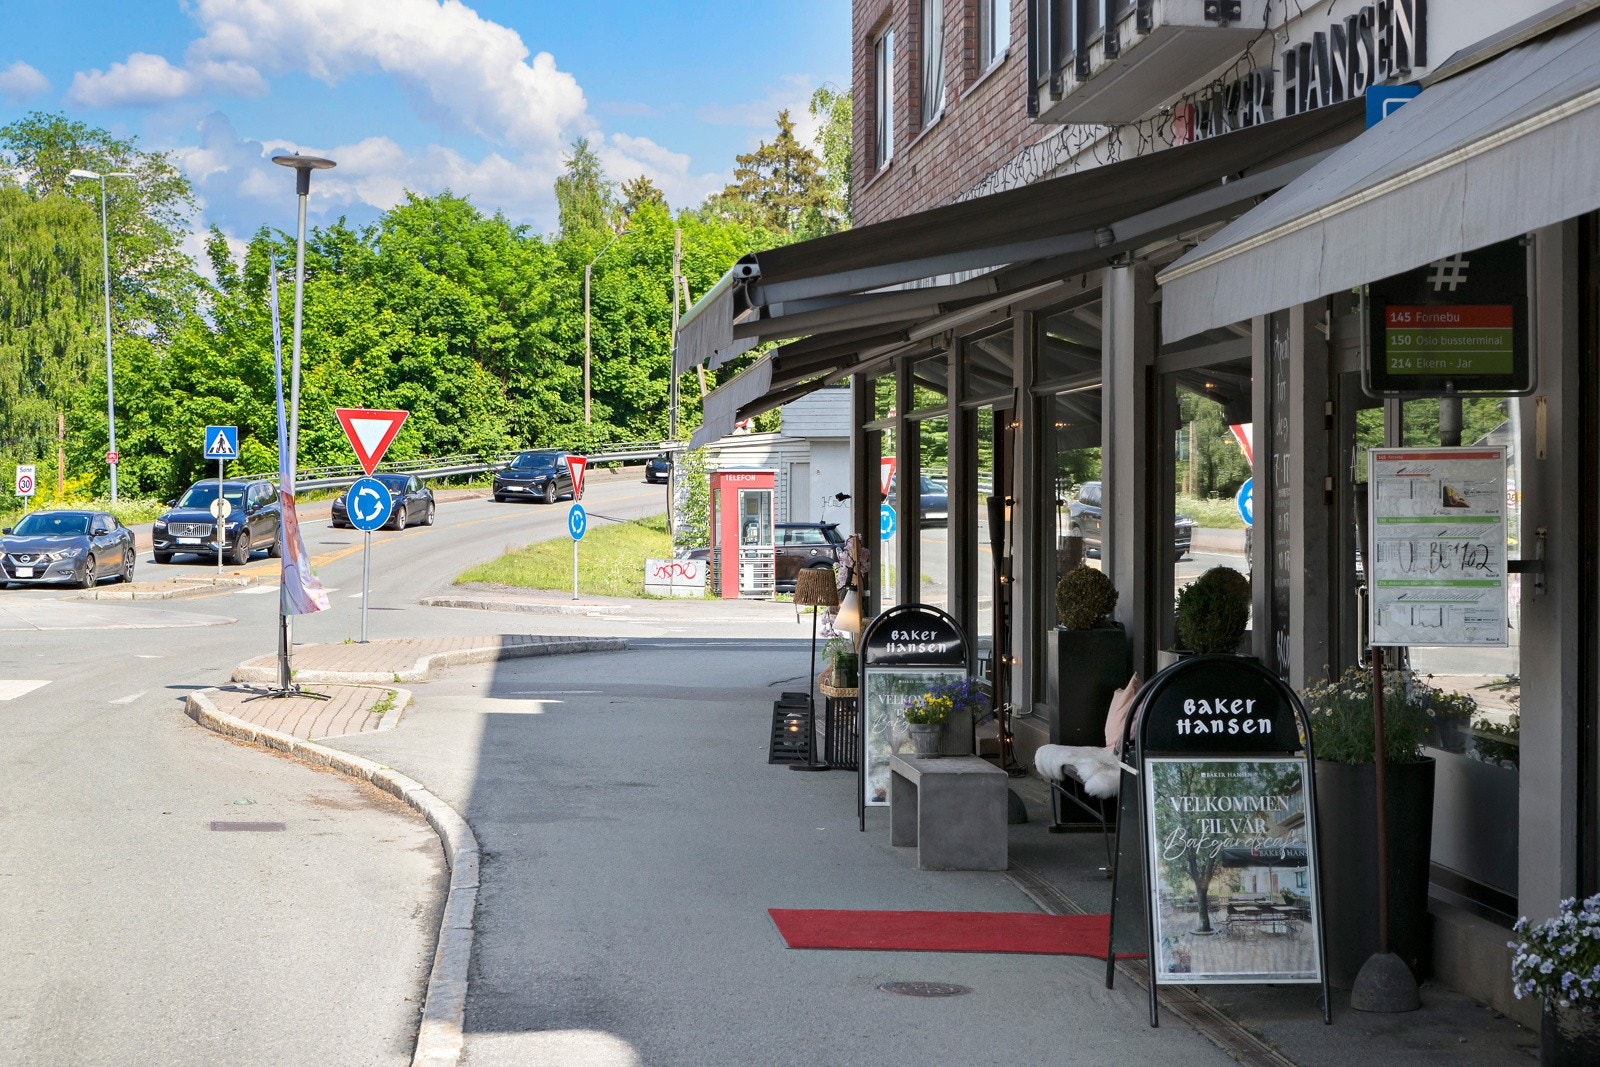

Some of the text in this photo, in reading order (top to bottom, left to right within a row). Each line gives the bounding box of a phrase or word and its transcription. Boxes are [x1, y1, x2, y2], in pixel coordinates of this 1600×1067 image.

[1281, 0, 1427, 118] HANSEN
[1390, 311, 1460, 322] 145 Fornebu
[1391, 334, 1503, 346] 150 Oslo bussterminal
[1391, 359, 1412, 369] 214
[1416, 358, 1447, 369] Ekern
[1456, 358, 1473, 369] Jar
[725, 474, 756, 482] TELEFON
[21, 480, 30, 488] 30
[1170, 795, 1290, 813] VELKOMMEN
[1197, 815, 1267, 834] TIL VÅR
